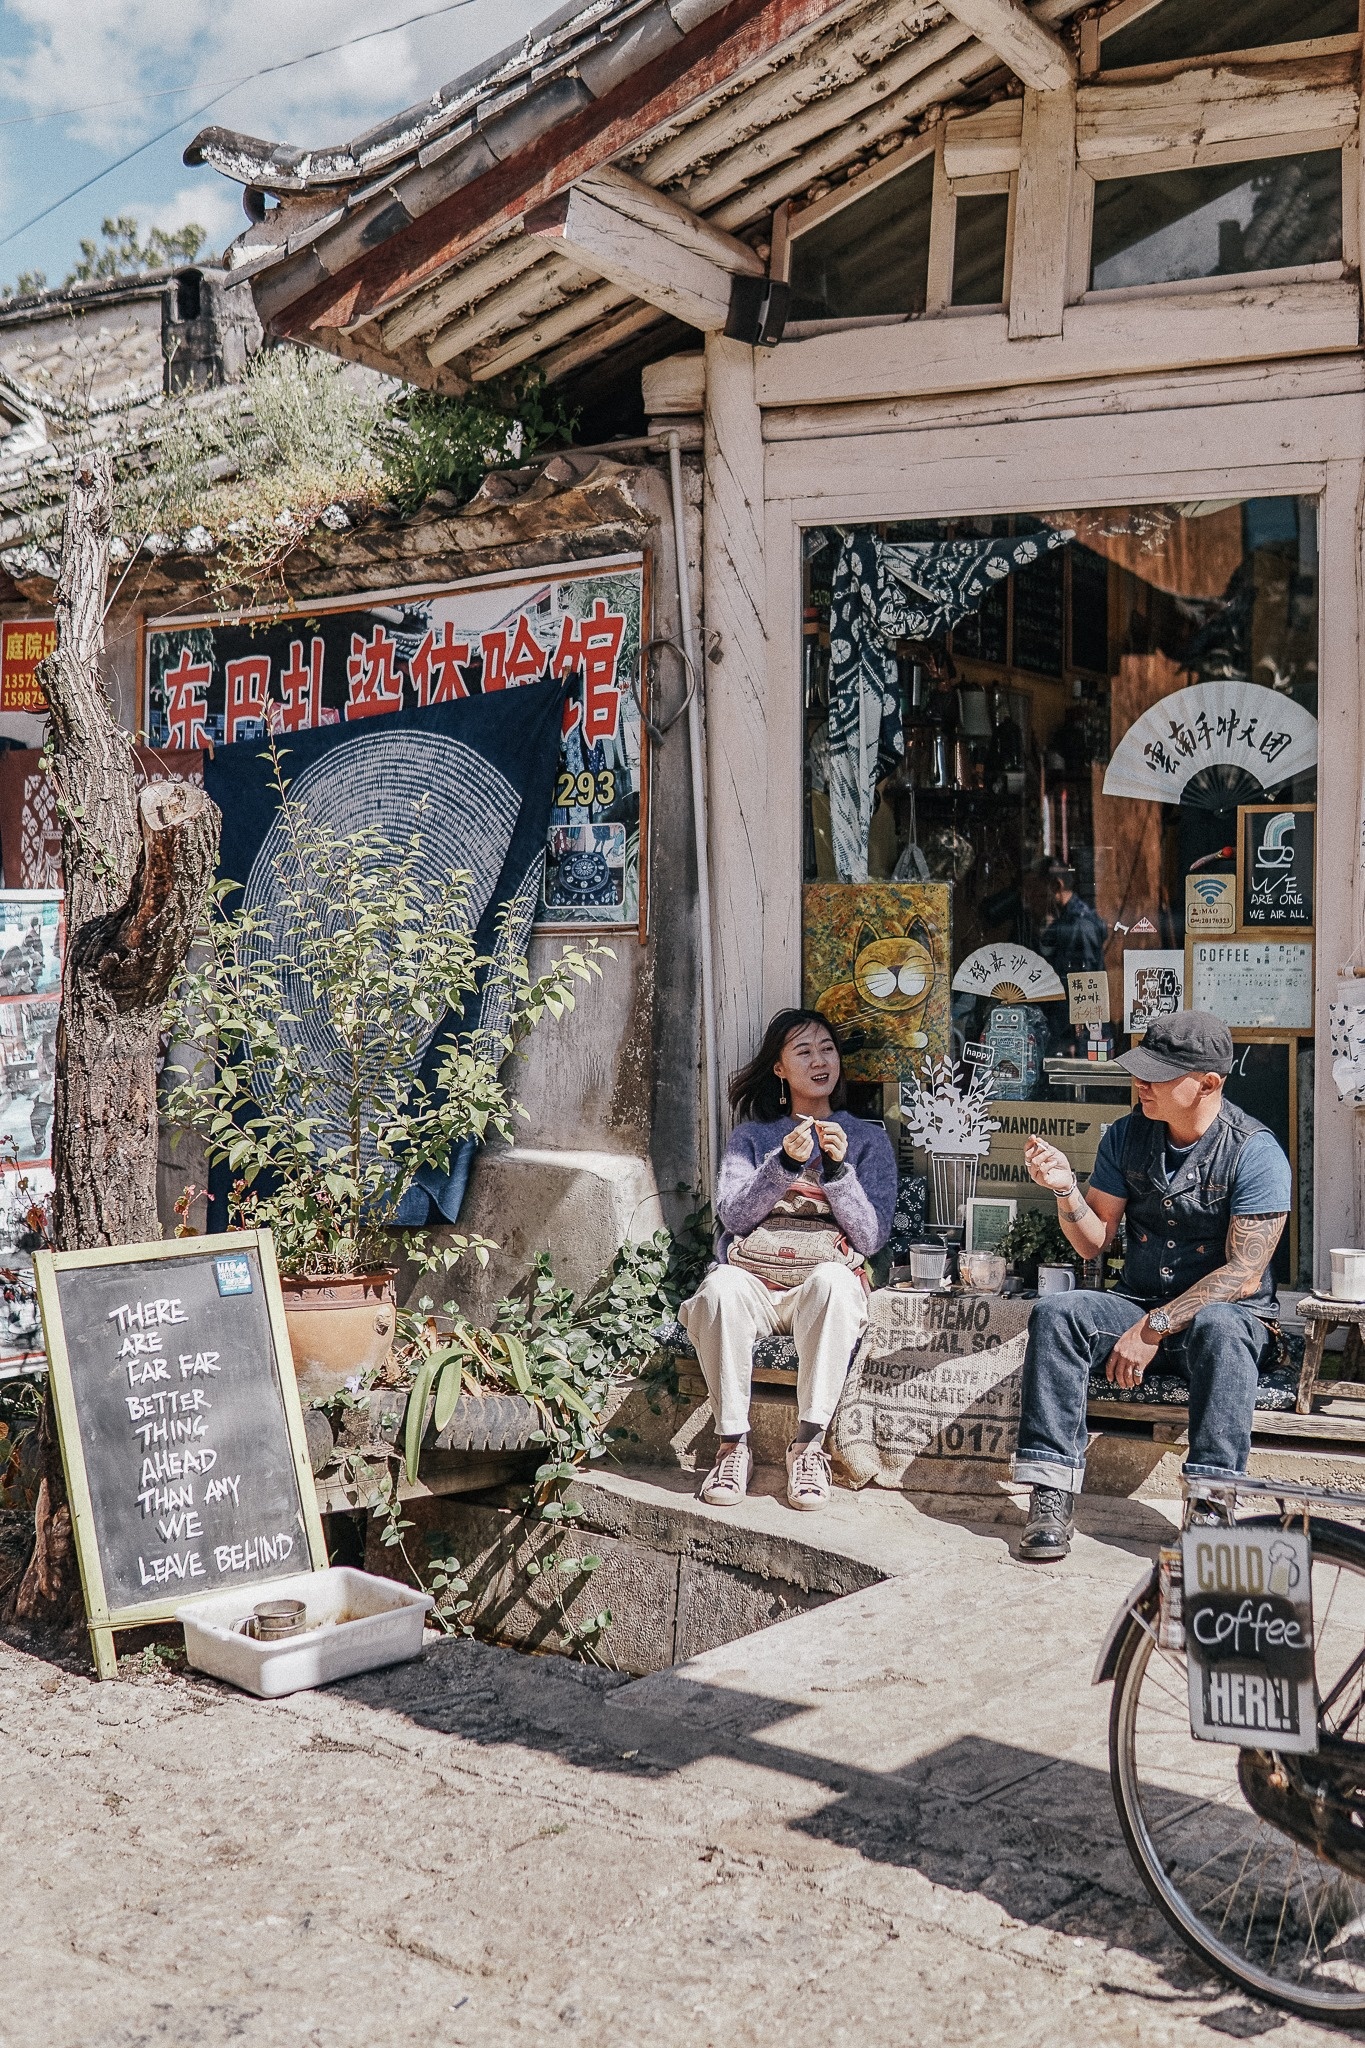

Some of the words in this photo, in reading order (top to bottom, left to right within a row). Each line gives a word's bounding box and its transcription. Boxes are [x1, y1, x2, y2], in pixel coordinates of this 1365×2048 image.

[553, 770, 616, 807] 293
[1250, 893, 1274, 905] ARE
[1279, 893, 1303, 905] ONE
[1251, 873, 1297, 894] WE
[1249, 909, 1265, 920] WE
[1270, 909, 1287, 919] AIR
[1199, 948, 1249, 962] COFFEE
[966, 1047, 992, 1062] happy
[109, 1298, 189, 1331] THERE
[890, 1297, 990, 1332] SUPREMO
[118, 1331, 163, 1359] ARE
[128, 1358, 171, 1387] FAR
[180, 1351, 221, 1378] FAR
[125, 1388, 212, 1420] BETTER
[135, 1414, 209, 1445] THING
[848, 1408, 863, 1436] 3
[141, 1448, 217, 1487] AHEAD
[137, 1483, 193, 1513] THAN
[204, 1475, 241, 1506] ANY
[159, 1512, 204, 1539] WE
[138, 1552, 206, 1586] LEAVE
[214, 1533, 293, 1574] BEHIND
[1196, 1542, 1263, 1595] COLD
[1193, 1599, 1313, 1652] Coffee
